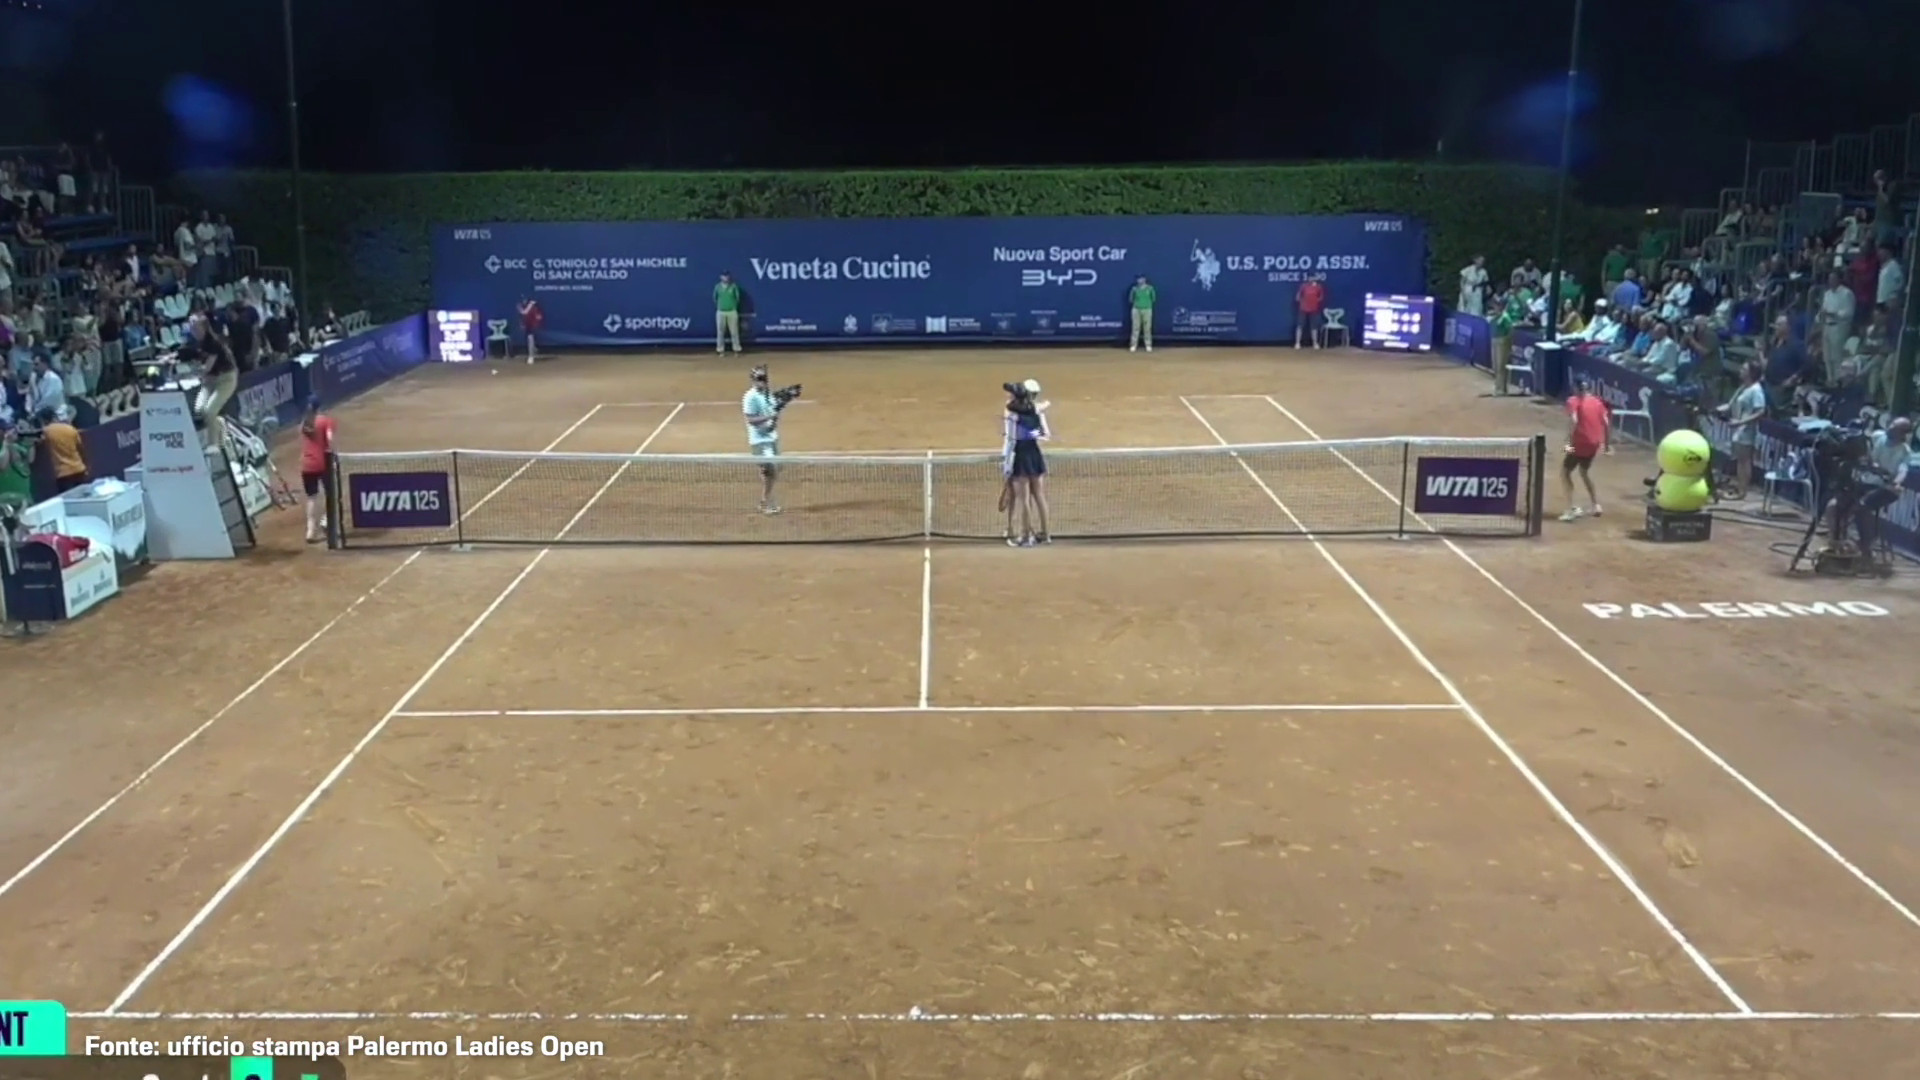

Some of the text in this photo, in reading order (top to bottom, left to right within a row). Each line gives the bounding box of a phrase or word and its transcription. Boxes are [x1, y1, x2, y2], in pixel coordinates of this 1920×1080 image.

[504, 257, 687, 269] BCC G. TONIOLO E SAN MICHELE
[993, 245, 1127, 264] Nuova Sport Car
[1226, 255, 1370, 270] U.S. POLO ASSN.
[533, 269, 628, 280] DI SAN CATALDO
[750, 254, 931, 280] Veneta Cucine
[1022, 269, 1098, 286] BYD
[1268, 272, 1300, 282] SINCE
[625, 316, 691, 331] sportpay
[1426, 476, 1508, 498] WTA 125
[361, 490, 440, 512] WTA 125
[1582, 601, 1889, 619] PALERMO
